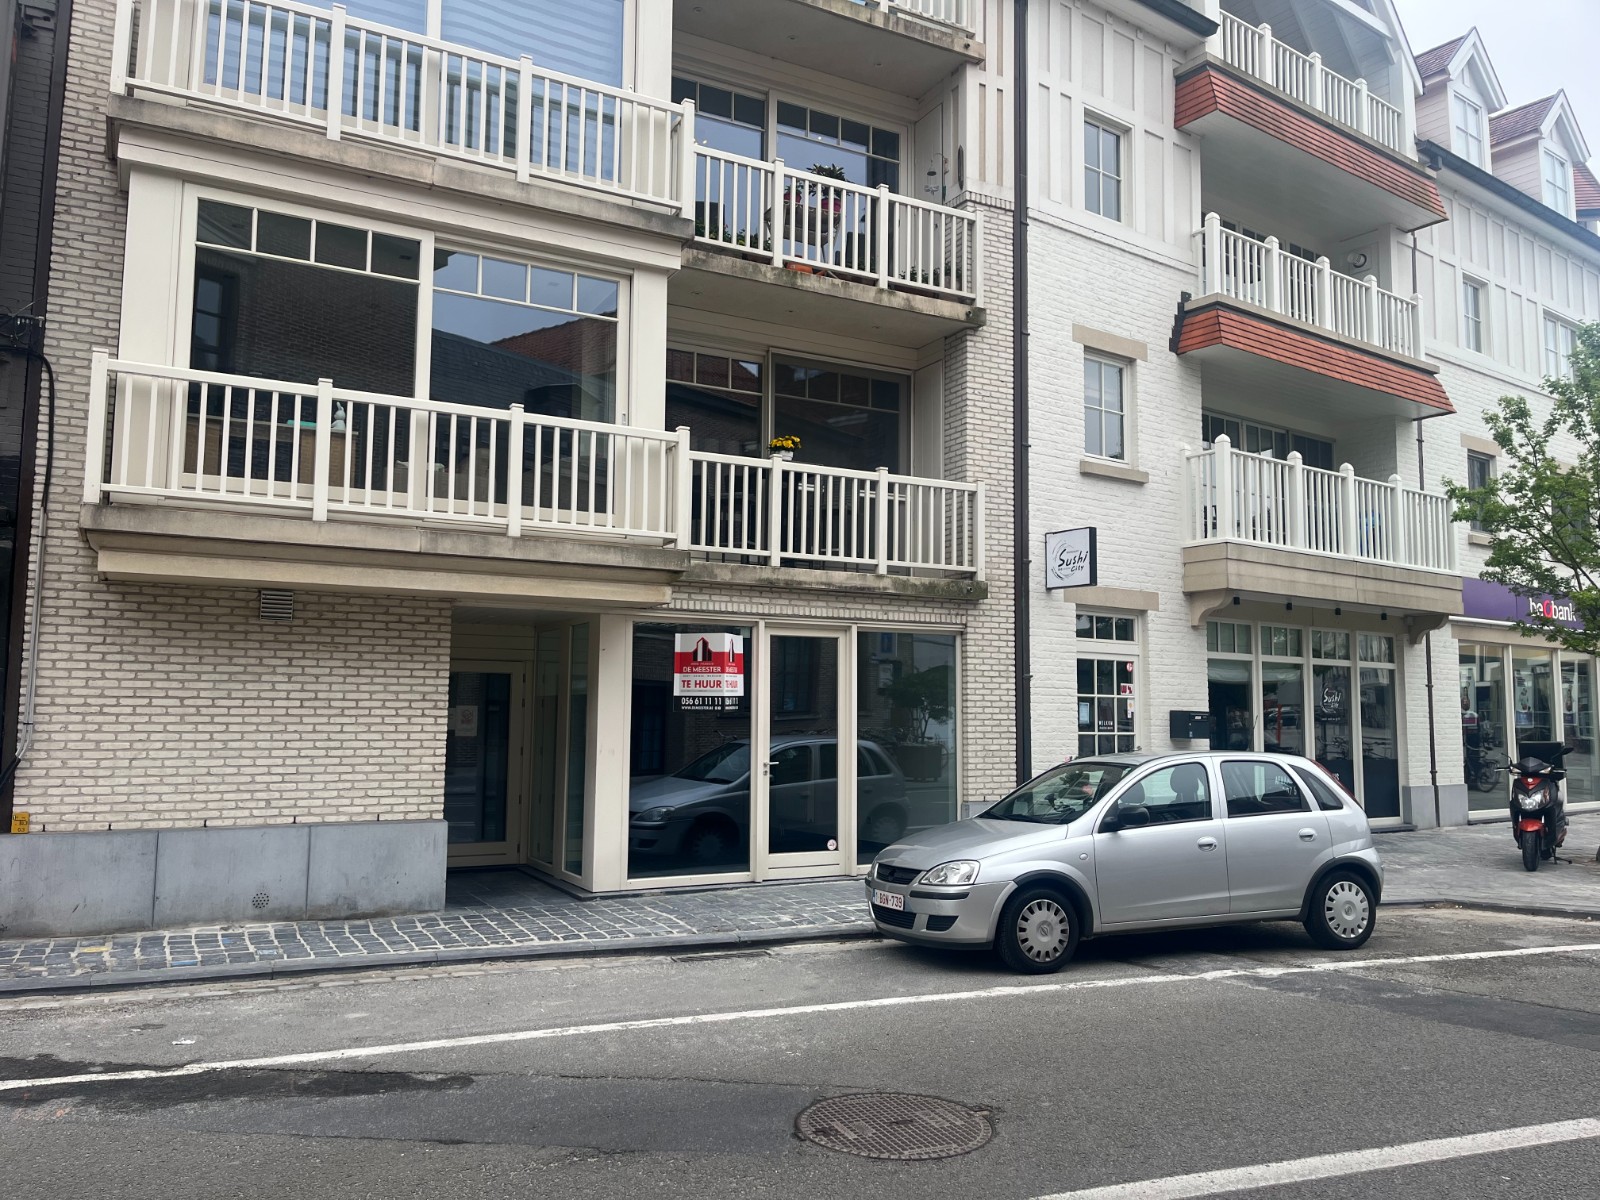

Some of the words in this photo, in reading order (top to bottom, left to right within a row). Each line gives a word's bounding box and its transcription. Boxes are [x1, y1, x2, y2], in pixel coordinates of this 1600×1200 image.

[1058, 548, 1088, 567] Sushi
[681, 679, 692, 689] TE
[694, 679, 722, 689] HUUR
[681, 697, 694, 705] 056
[694, 697, 702, 705] 61
[705, 697, 712, 705] 11
[714, 697, 722, 705] 11
